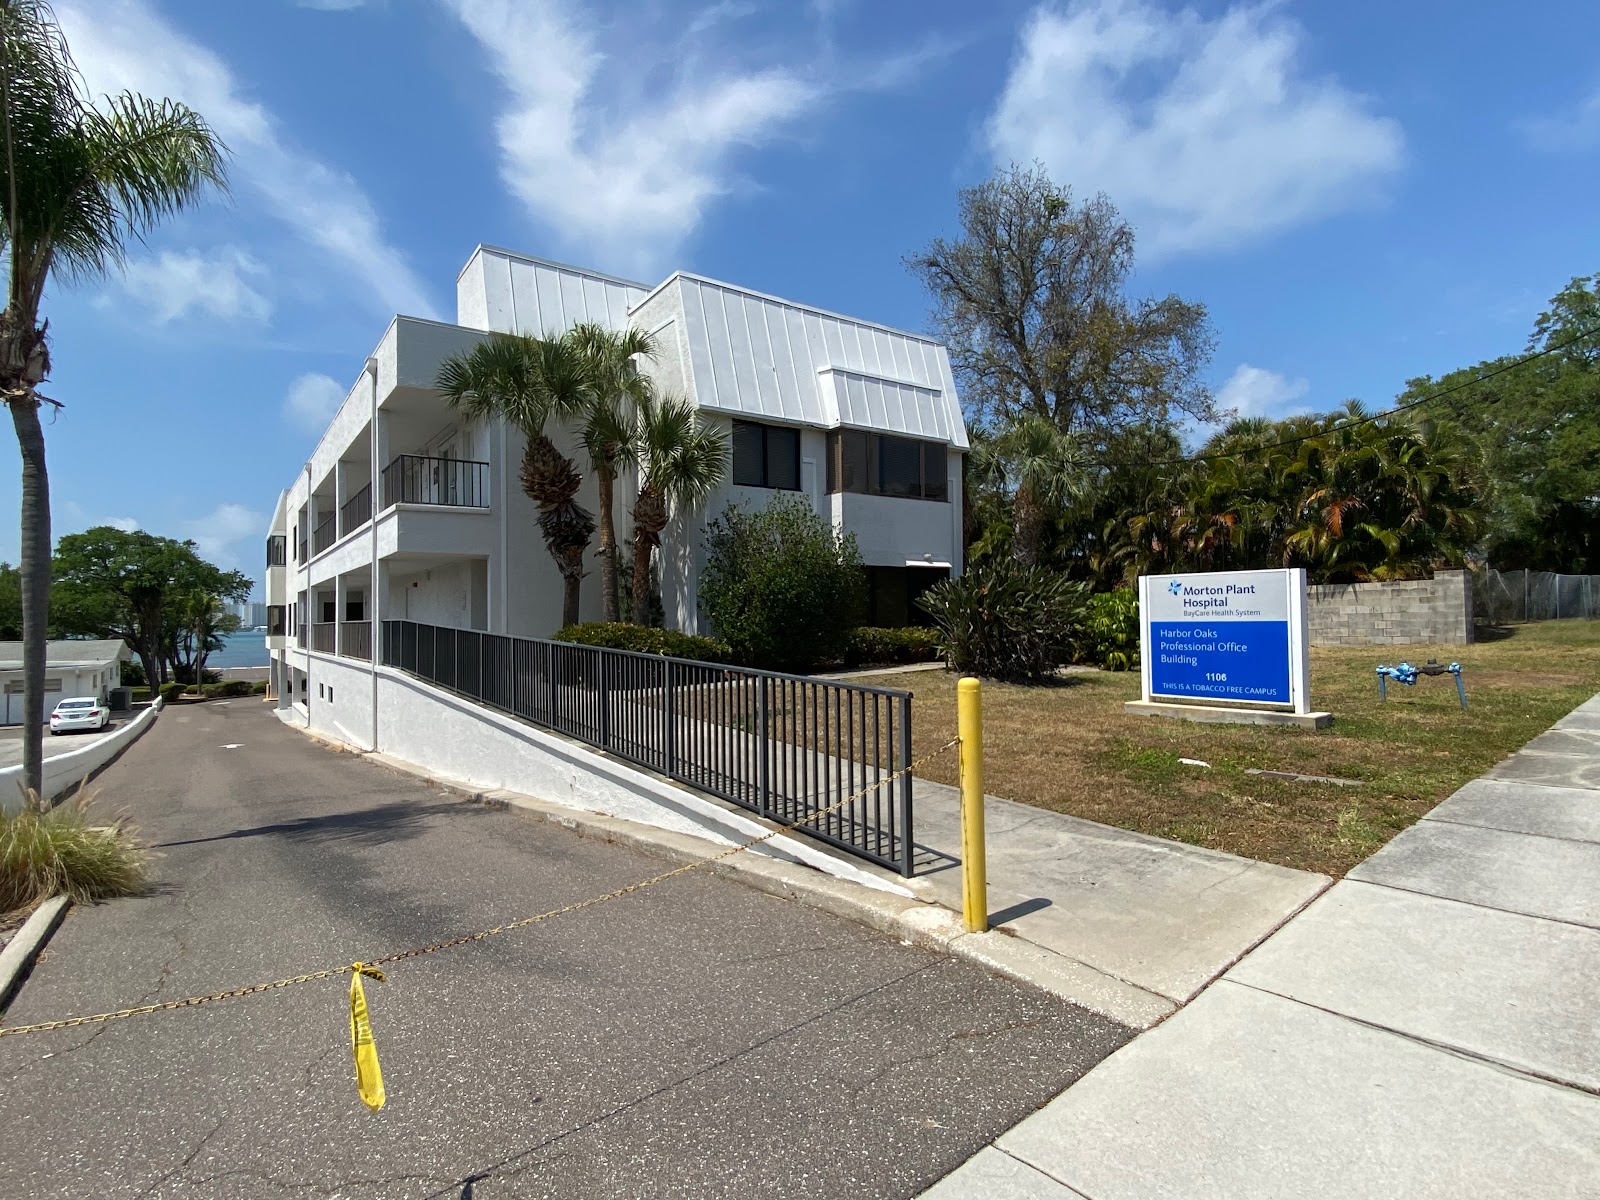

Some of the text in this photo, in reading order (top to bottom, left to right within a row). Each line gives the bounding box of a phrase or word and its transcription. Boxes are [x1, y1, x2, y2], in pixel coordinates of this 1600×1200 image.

[1183, 584, 1256, 596] Morton Plant
[1183, 597, 1228, 609] Hospital
[1183, 609, 1210, 618] BayCare
[1235, 609, 1261, 617] System
[1160, 628, 1218, 638] Harbor Oaks
[1160, 641, 1248, 652] Professional Office
[1160, 654, 1198, 667] Building
[1205, 672, 1227, 681] 1106
[1162, 682, 1177, 690] THIS
[1192, 684, 1226, 693] TOBACCO
[1226, 685, 1243, 694] FREE
[1244, 686, 1277, 696] CAMPUS
